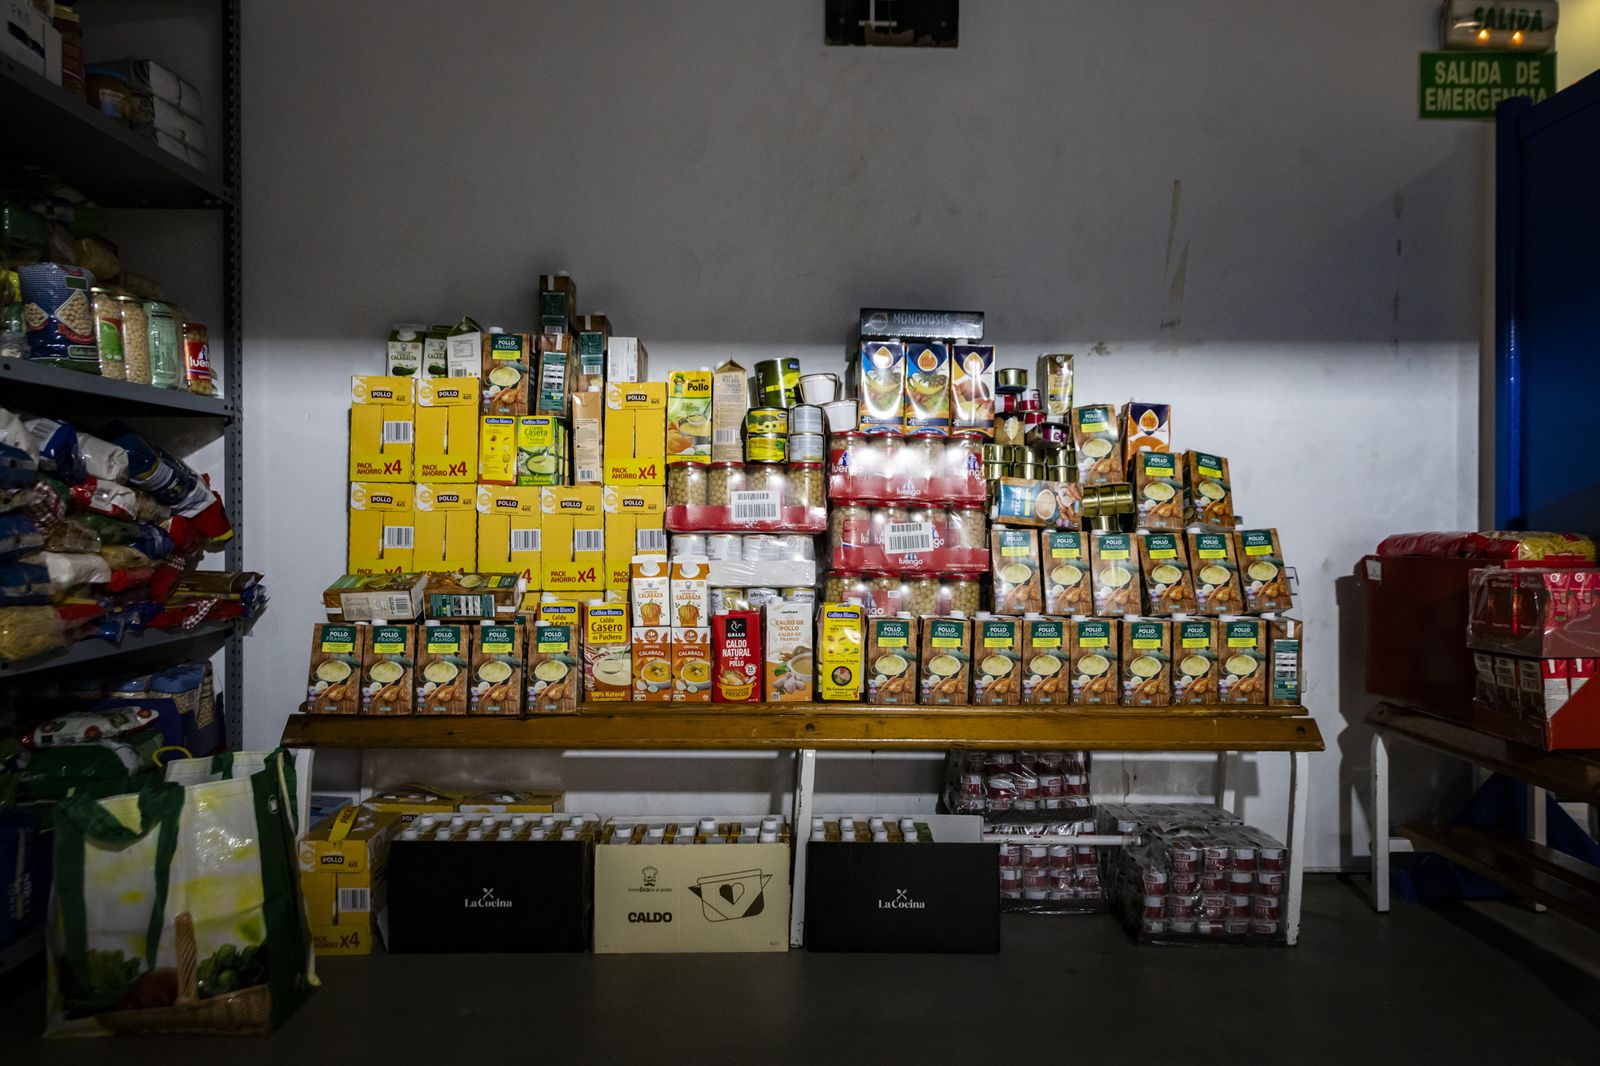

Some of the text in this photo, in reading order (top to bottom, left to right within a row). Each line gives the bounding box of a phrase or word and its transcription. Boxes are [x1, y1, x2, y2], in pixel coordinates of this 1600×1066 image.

[1473, 7, 1543, 32] SALIDA
[1435, 61, 1540, 84] SALIDA DE
[893, 313, 950, 326] MONODOSIS
[688, 383, 709, 391] Pollo
[384, 460, 402, 475] x4
[449, 461, 467, 476] x4
[638, 464, 657, 479] x4
[899, 557, 923, 566] luengo
[578, 568, 596, 583] x4
[591, 623, 623, 632] Casero
[726, 640, 747, 648] CALDO
[722, 648, 751, 657] NATURAL
[628, 912, 672, 923] CALDO
[340, 932, 360, 948] x4
